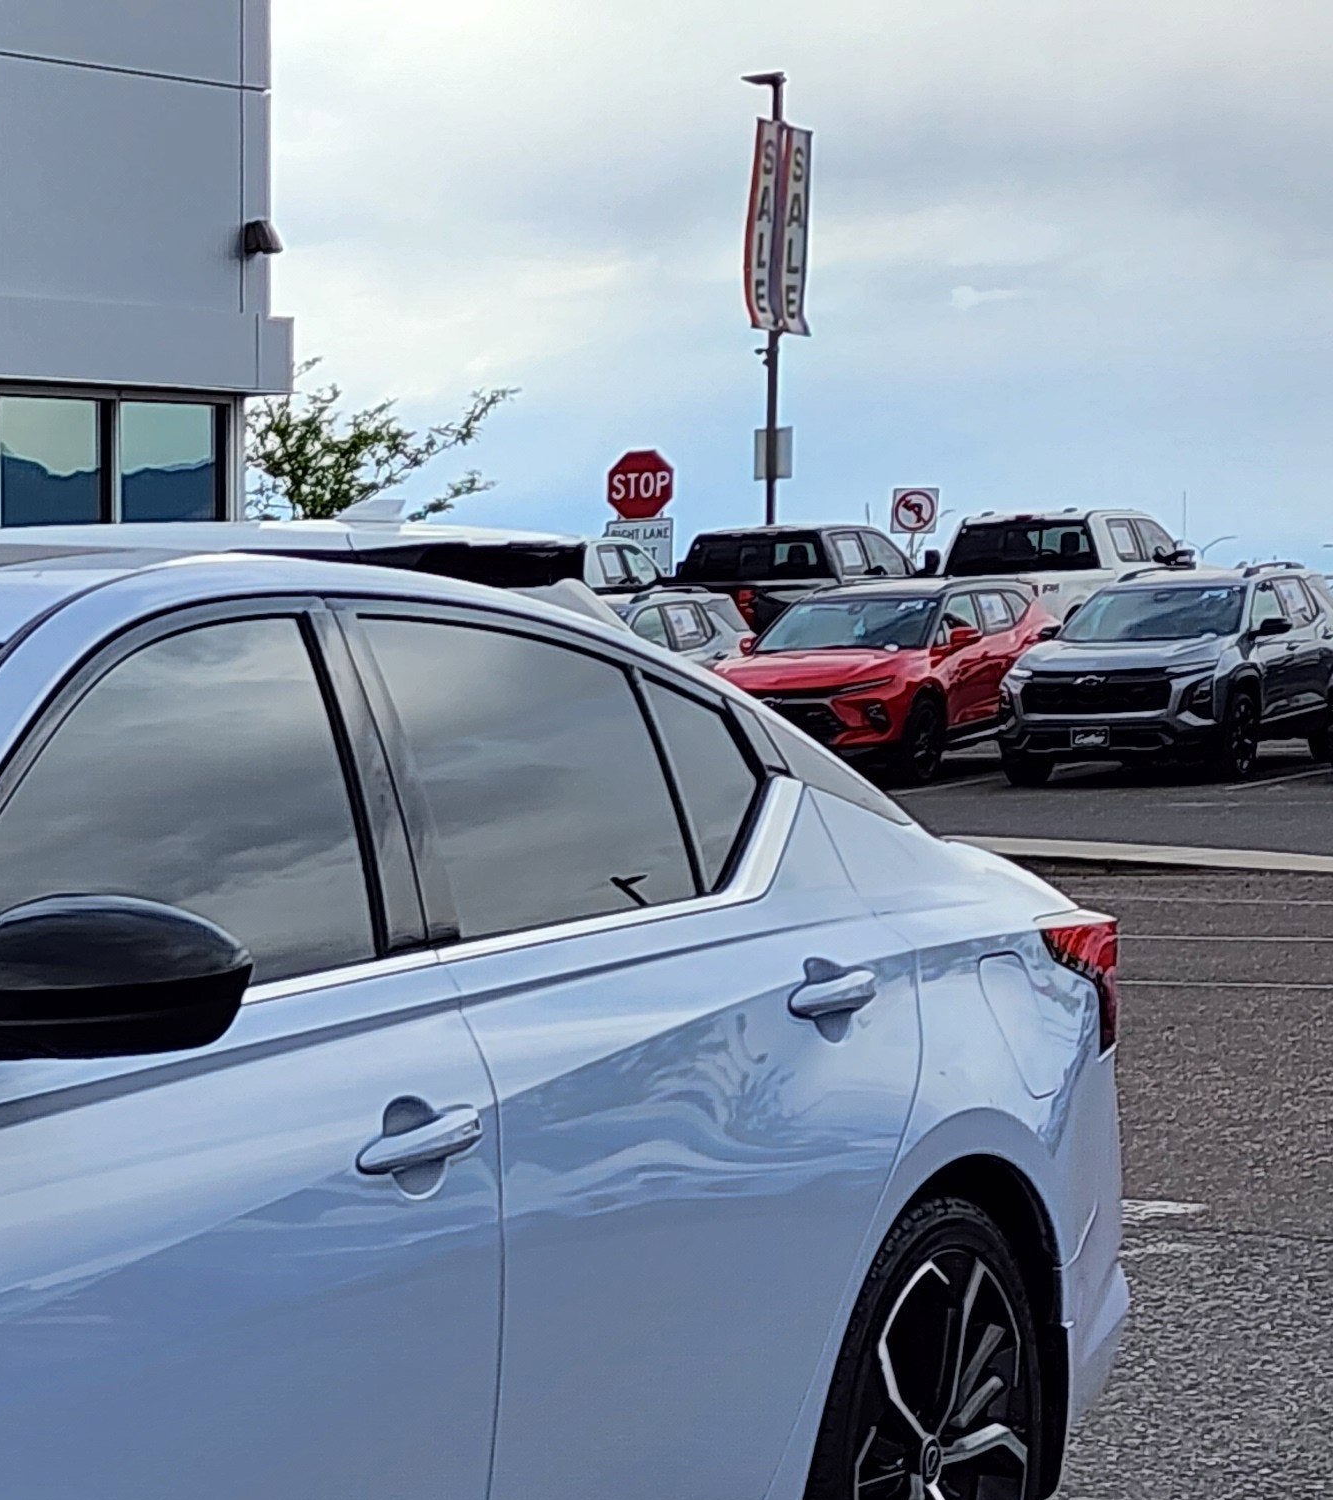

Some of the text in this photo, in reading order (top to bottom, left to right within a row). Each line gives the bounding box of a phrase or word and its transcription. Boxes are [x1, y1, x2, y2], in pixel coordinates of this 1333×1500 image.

[754, 139, 774, 314] SALE
[785, 147, 804, 320] SALE
[611, 471, 670, 500] STOP
[643, 527, 670, 540] LANE
